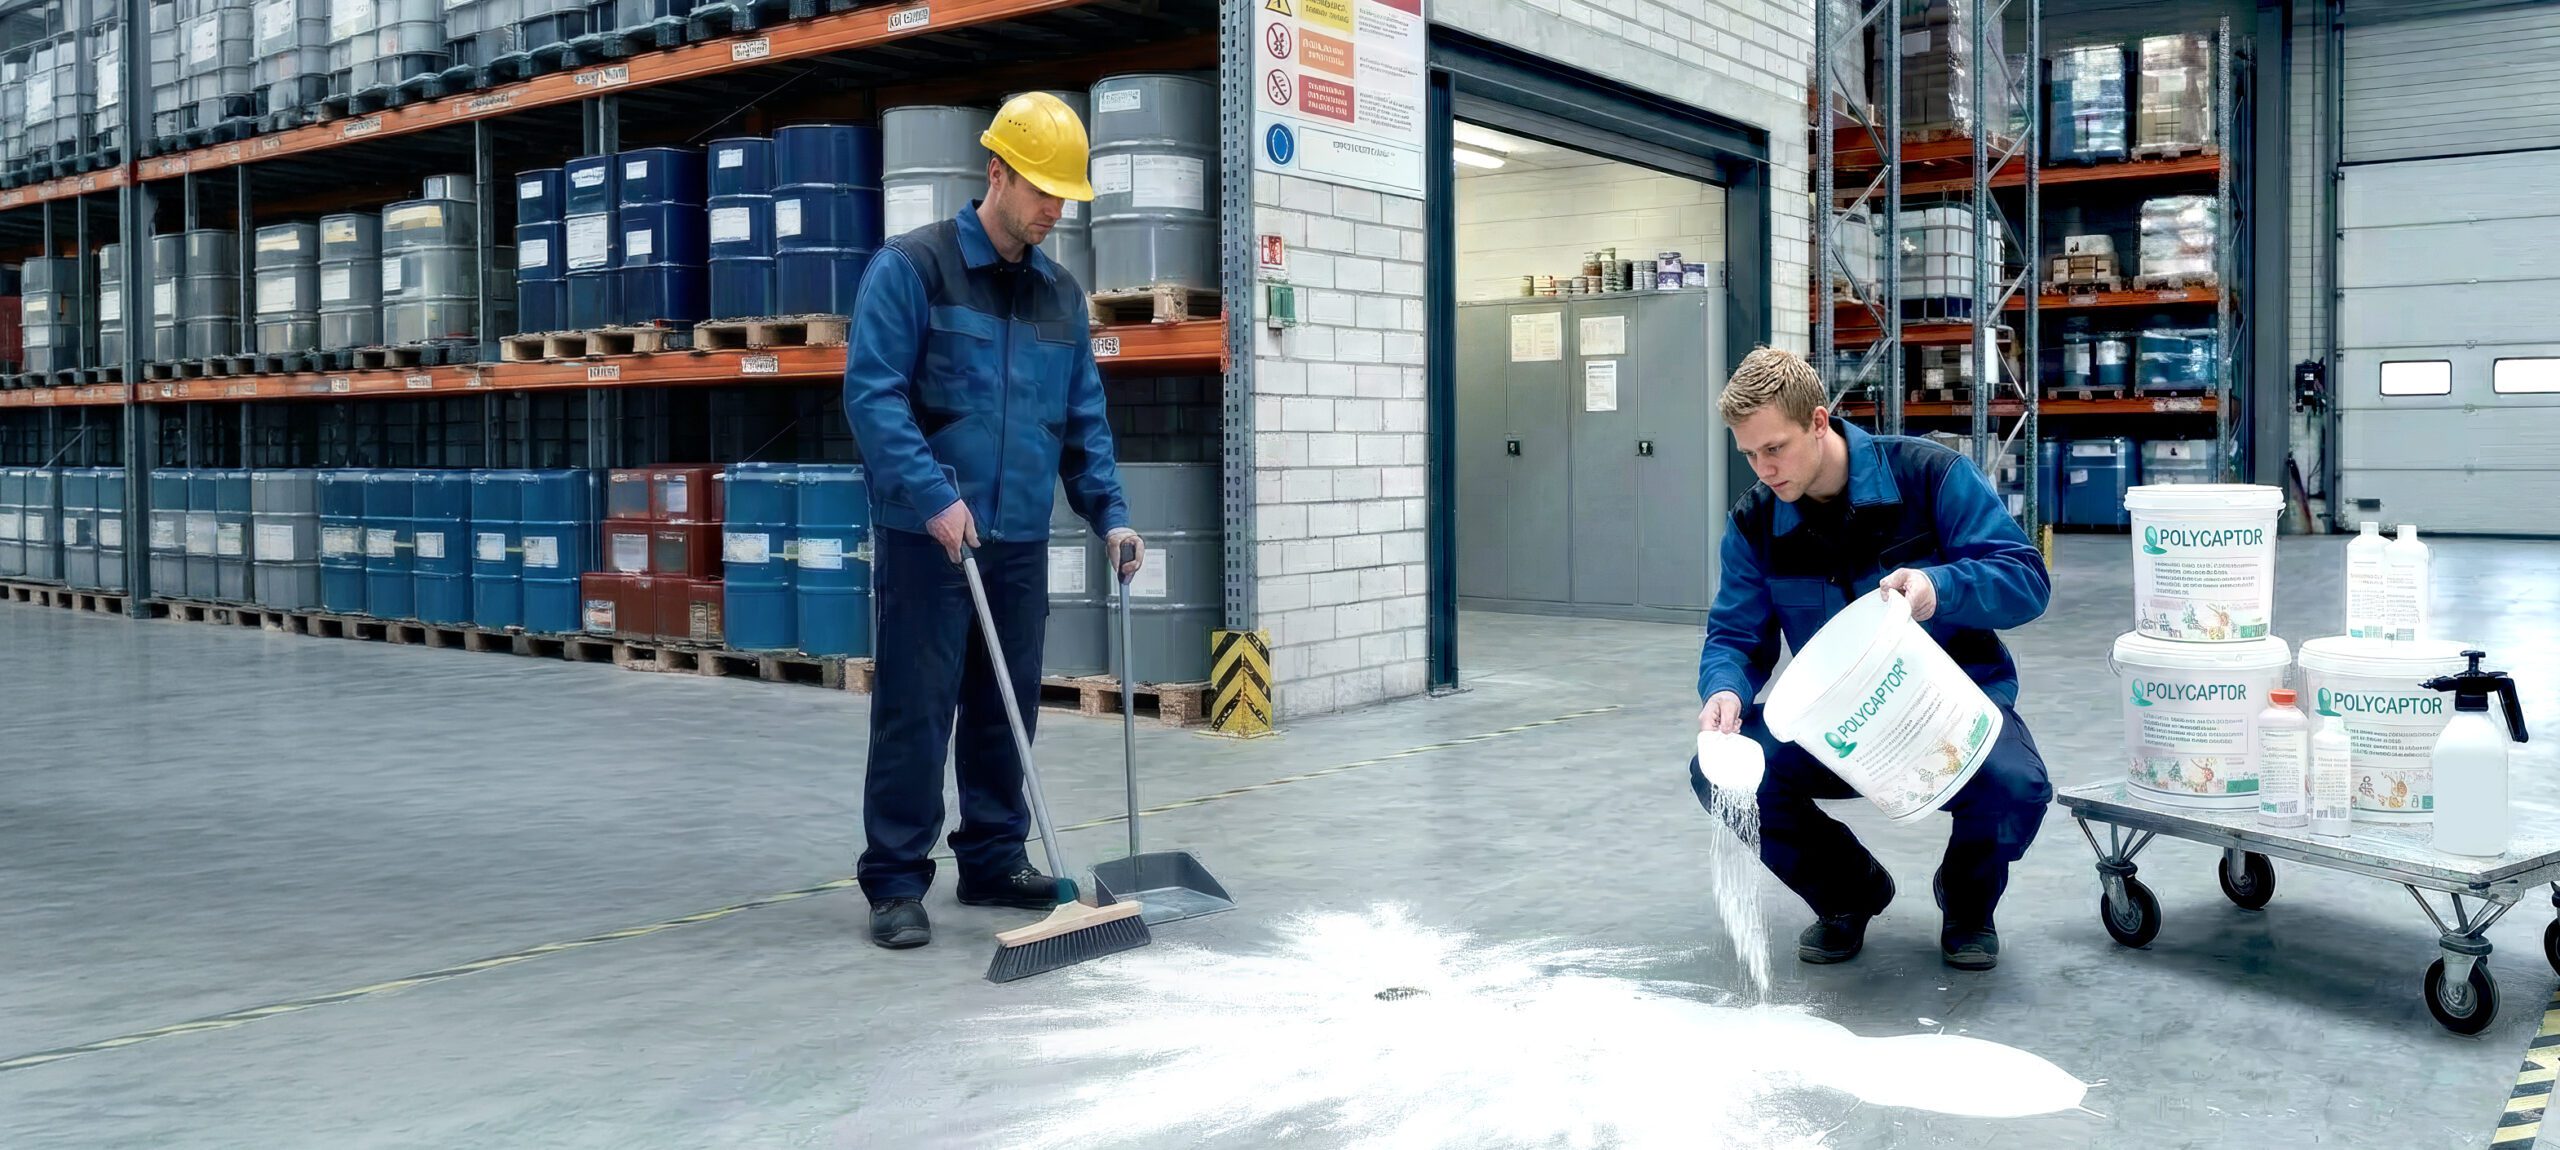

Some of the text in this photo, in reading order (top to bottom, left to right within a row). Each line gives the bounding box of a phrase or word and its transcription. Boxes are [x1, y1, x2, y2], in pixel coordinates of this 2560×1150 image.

[2160, 528, 2263, 547] POLYCAPTOR
[2146, 682, 2247, 701] POLYCAPTOR
[2334, 692, 2443, 715] POLYCAPTOR
